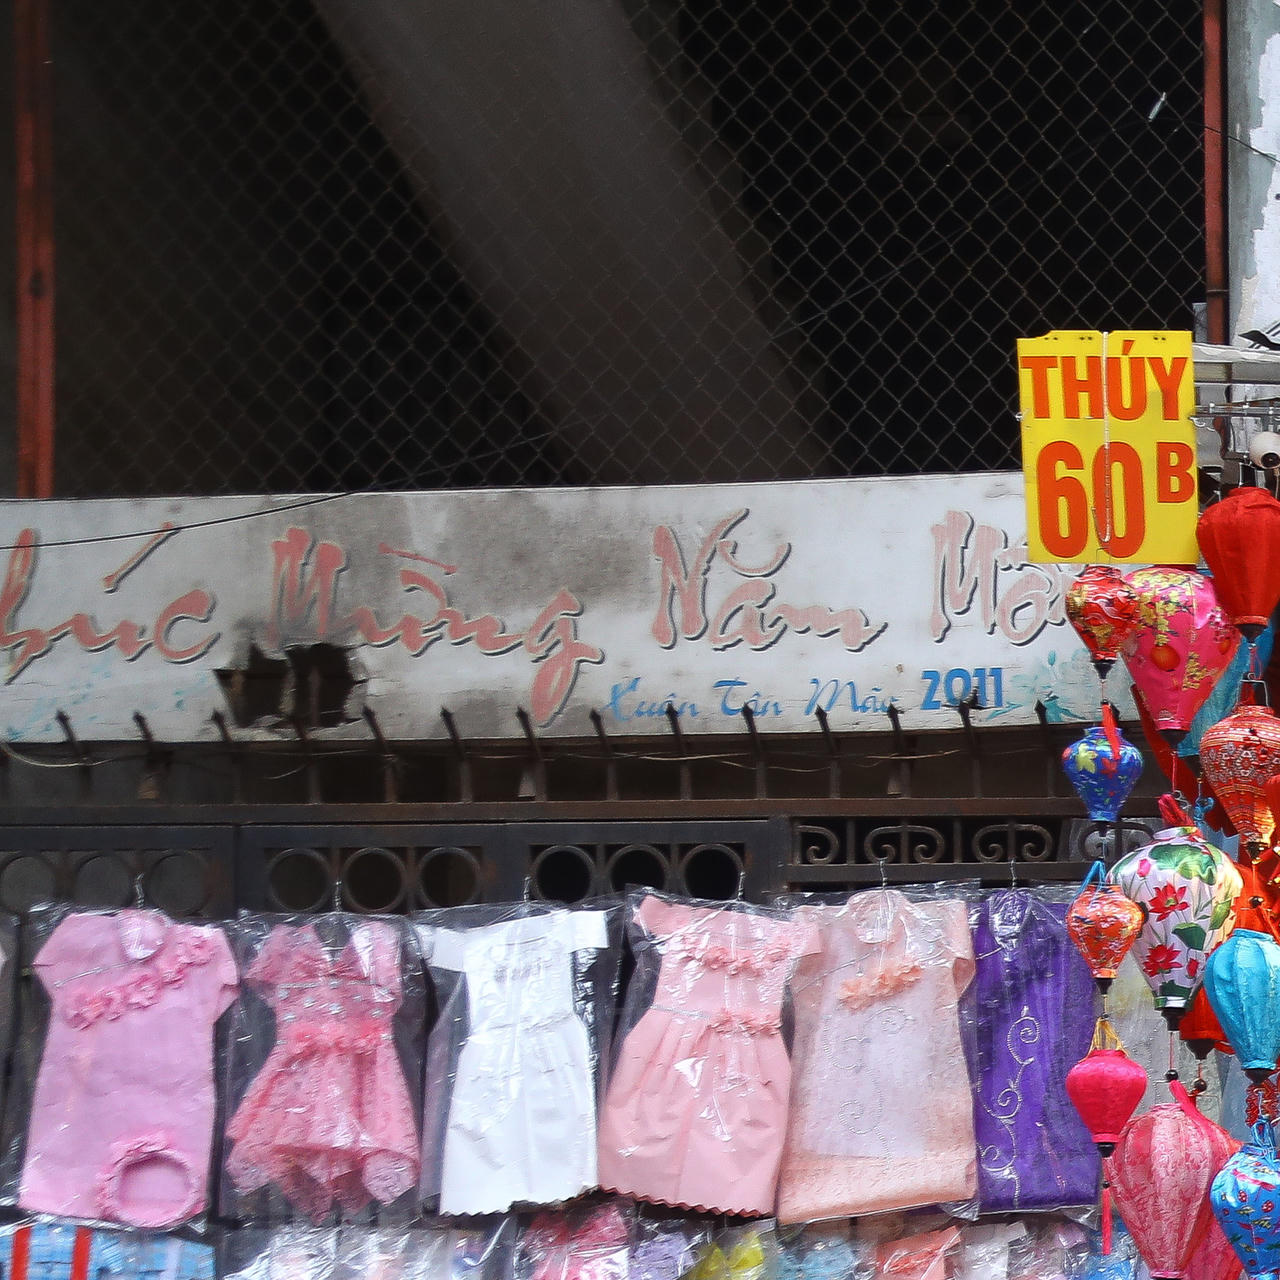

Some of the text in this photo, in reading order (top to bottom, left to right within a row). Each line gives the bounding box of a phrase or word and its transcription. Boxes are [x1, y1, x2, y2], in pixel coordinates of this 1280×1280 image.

[1020, 340, 1189, 421] THÚY
[0, 520, 222, 685] húc
[650, 507, 889, 653] Năm
[920, 667, 1004, 711] 2011
